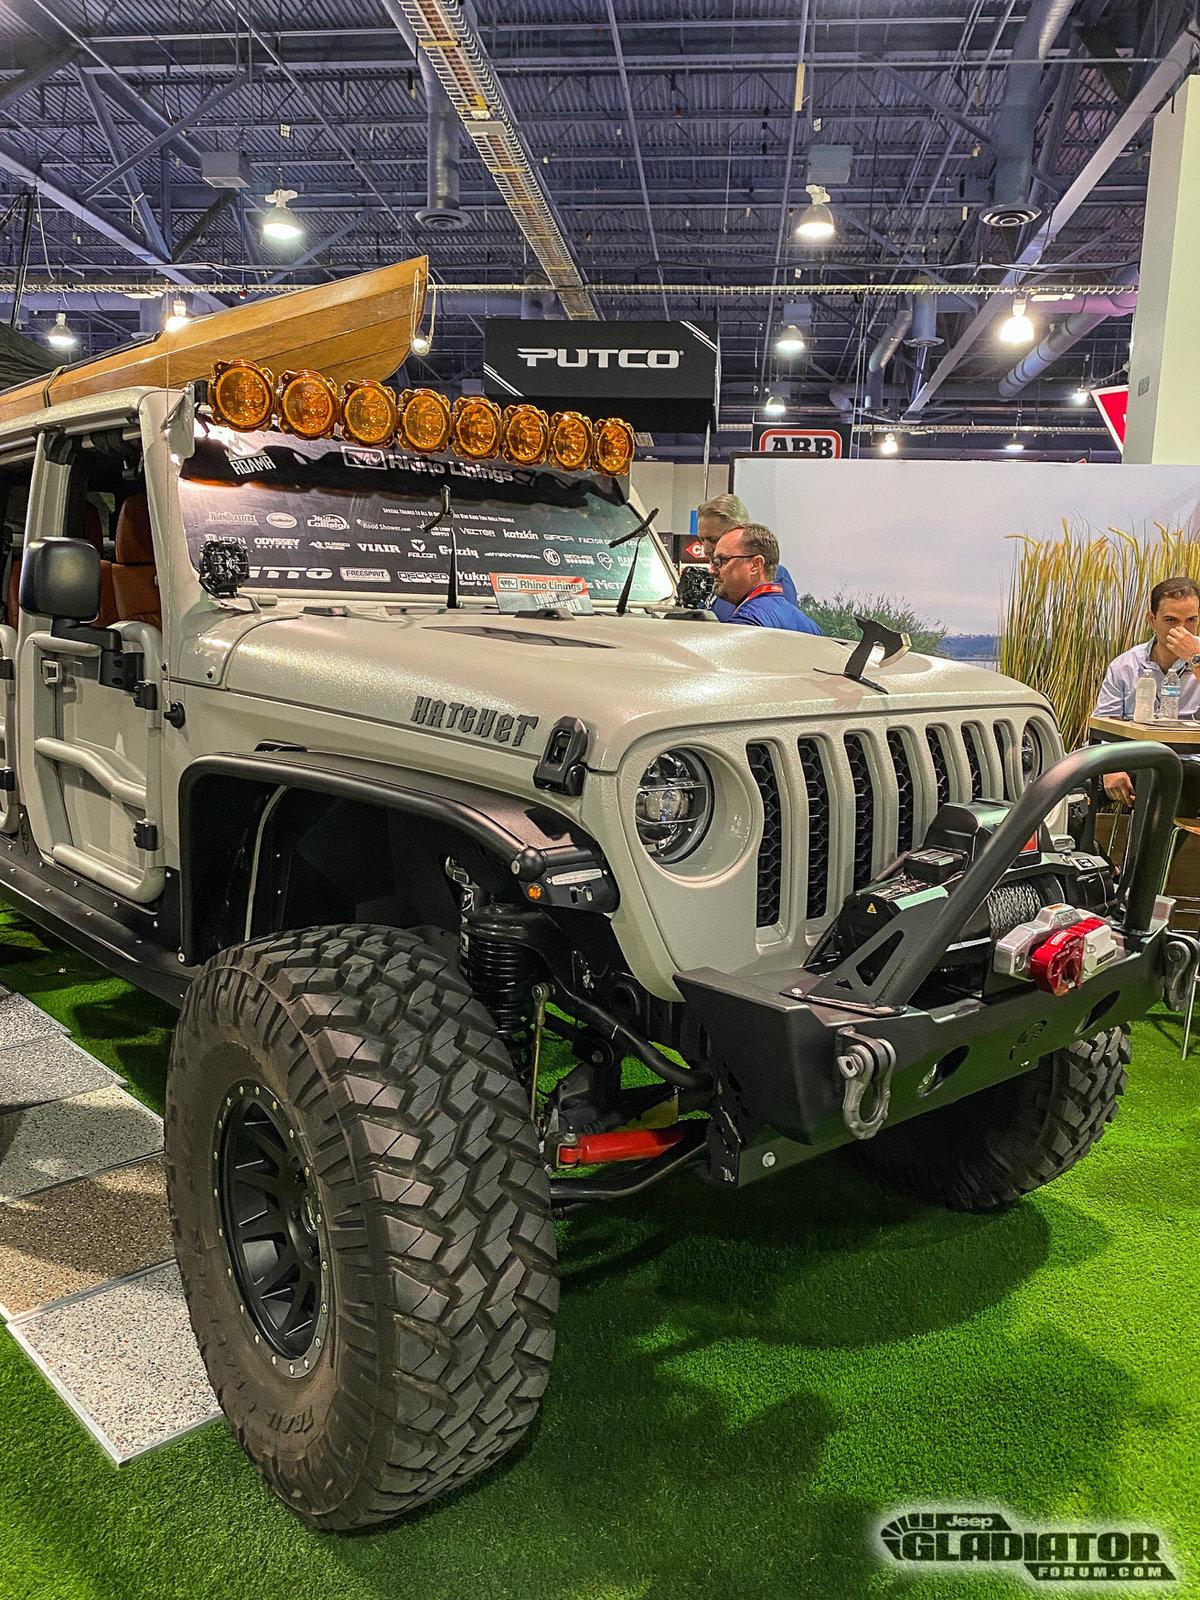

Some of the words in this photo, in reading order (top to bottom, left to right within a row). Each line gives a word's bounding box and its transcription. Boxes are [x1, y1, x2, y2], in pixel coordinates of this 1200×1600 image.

[517, 347, 679, 369] PUTCO
[772, 437, 833, 457] ARB
[388, 453, 445, 474] Rhino
[448, 461, 514, 483] Linings
[363, 522, 379, 530] Road
[254, 537, 300, 545] ODYSSEY
[503, 529, 538, 540] katzkin
[357, 543, 401, 553] VIAIR
[438, 545, 479, 558] Grzzly
[249, 566, 333, 580] ITTO
[520, 580, 547, 590] Rhino
[548, 581, 582, 593] Linings
